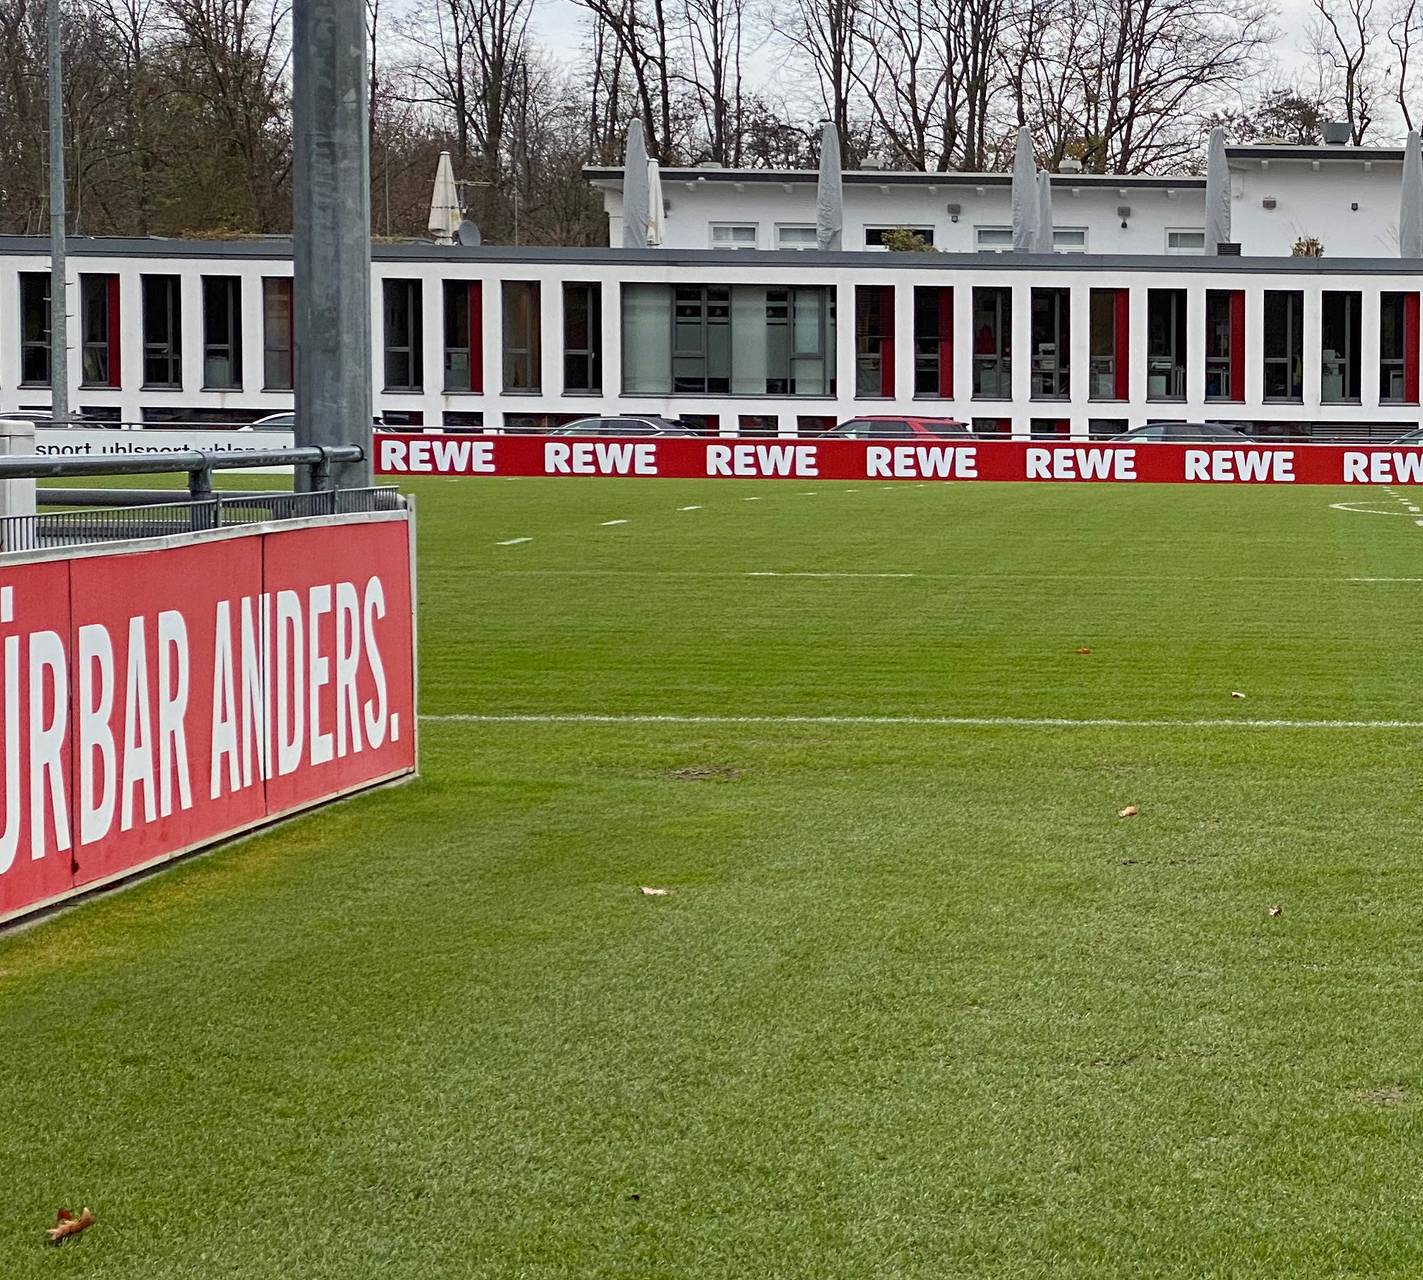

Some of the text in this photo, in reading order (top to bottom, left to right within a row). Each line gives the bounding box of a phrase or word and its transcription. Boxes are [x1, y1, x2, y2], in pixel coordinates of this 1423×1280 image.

[381, 441, 496, 472] REWE
[544, 442, 658, 474] REWE
[706, 444, 818, 476] REWE
[866, 446, 978, 477] REWE
[1026, 448, 1137, 479] REWE
[1185, 450, 1296, 481] REWE
[210, 576, 399, 800] ANDERS.
